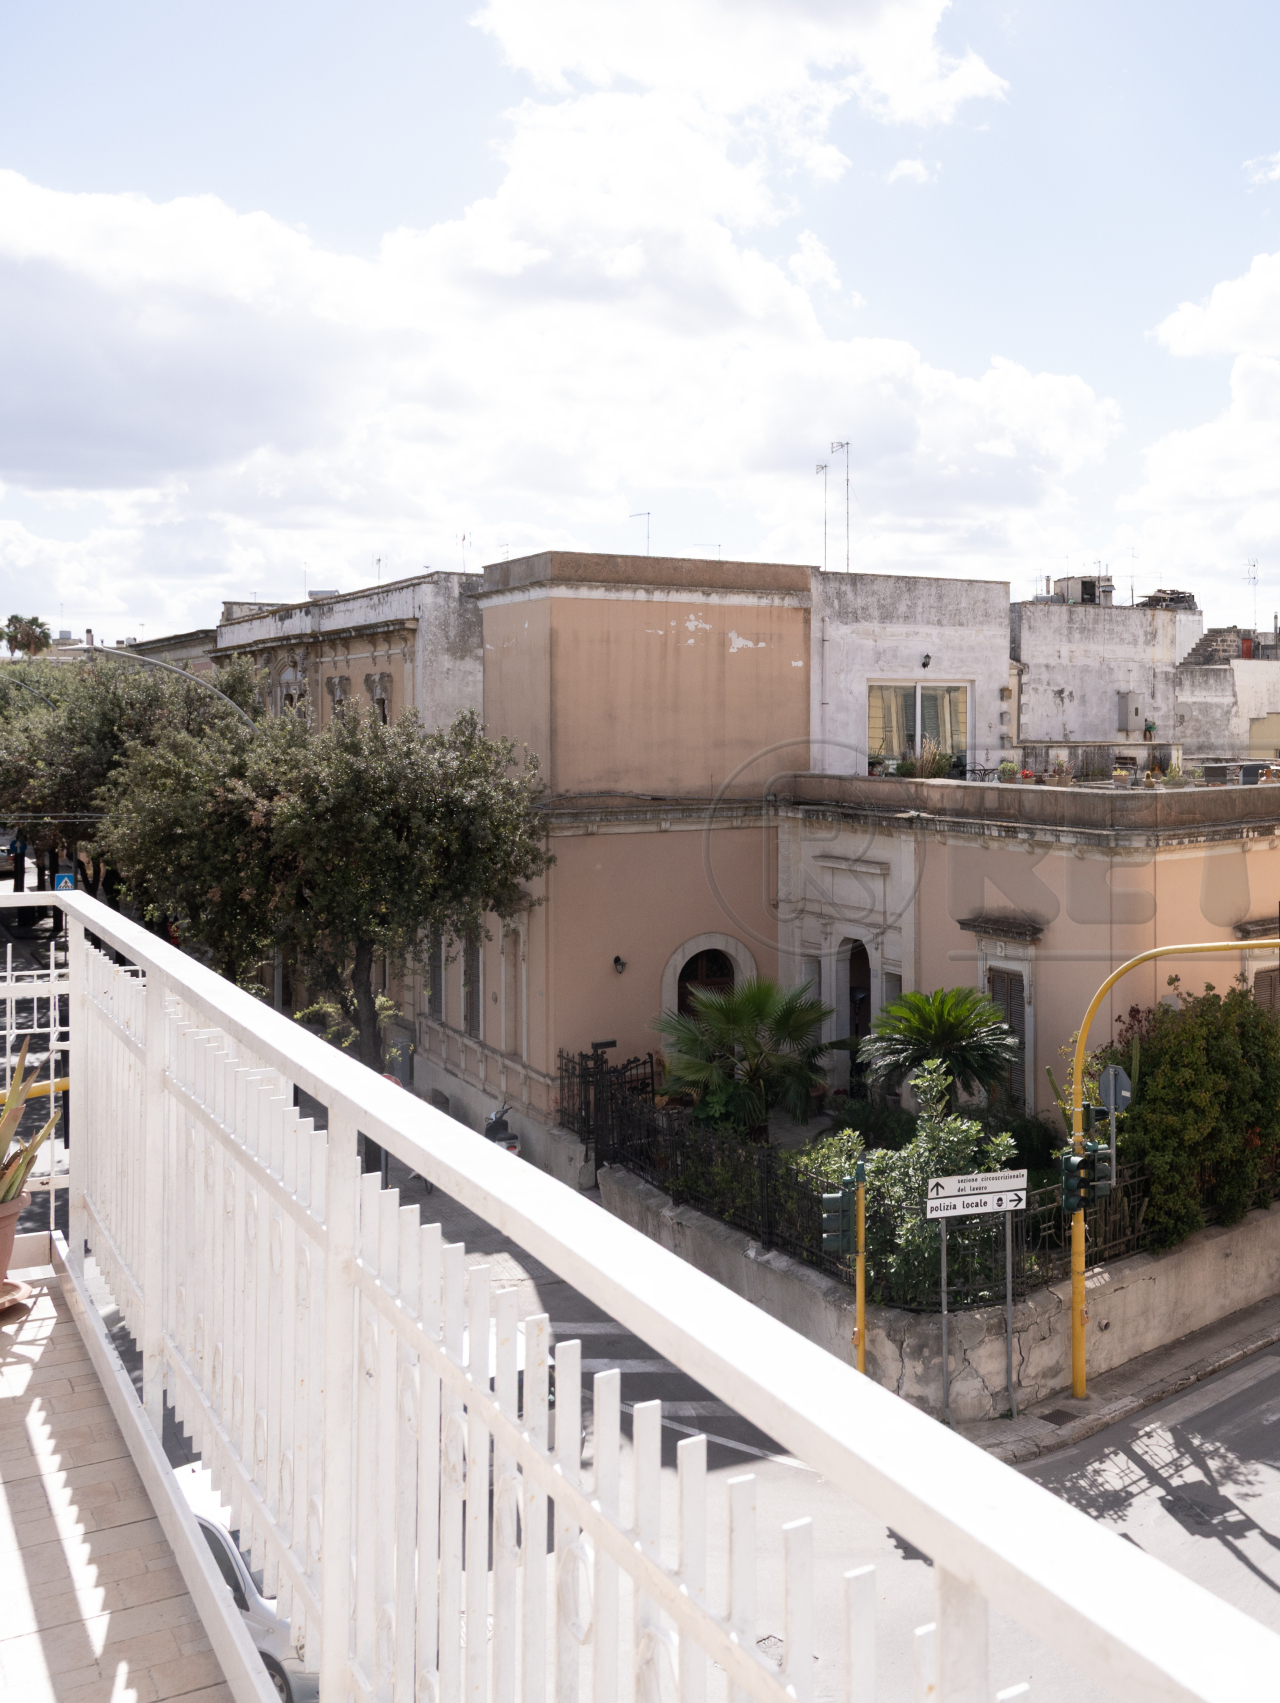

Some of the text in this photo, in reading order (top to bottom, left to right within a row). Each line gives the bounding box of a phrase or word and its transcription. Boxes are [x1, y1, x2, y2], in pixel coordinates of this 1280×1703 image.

[981, 1173, 1025, 1181] circoscrizionale
[930, 1198, 988, 1213] polizia locale
